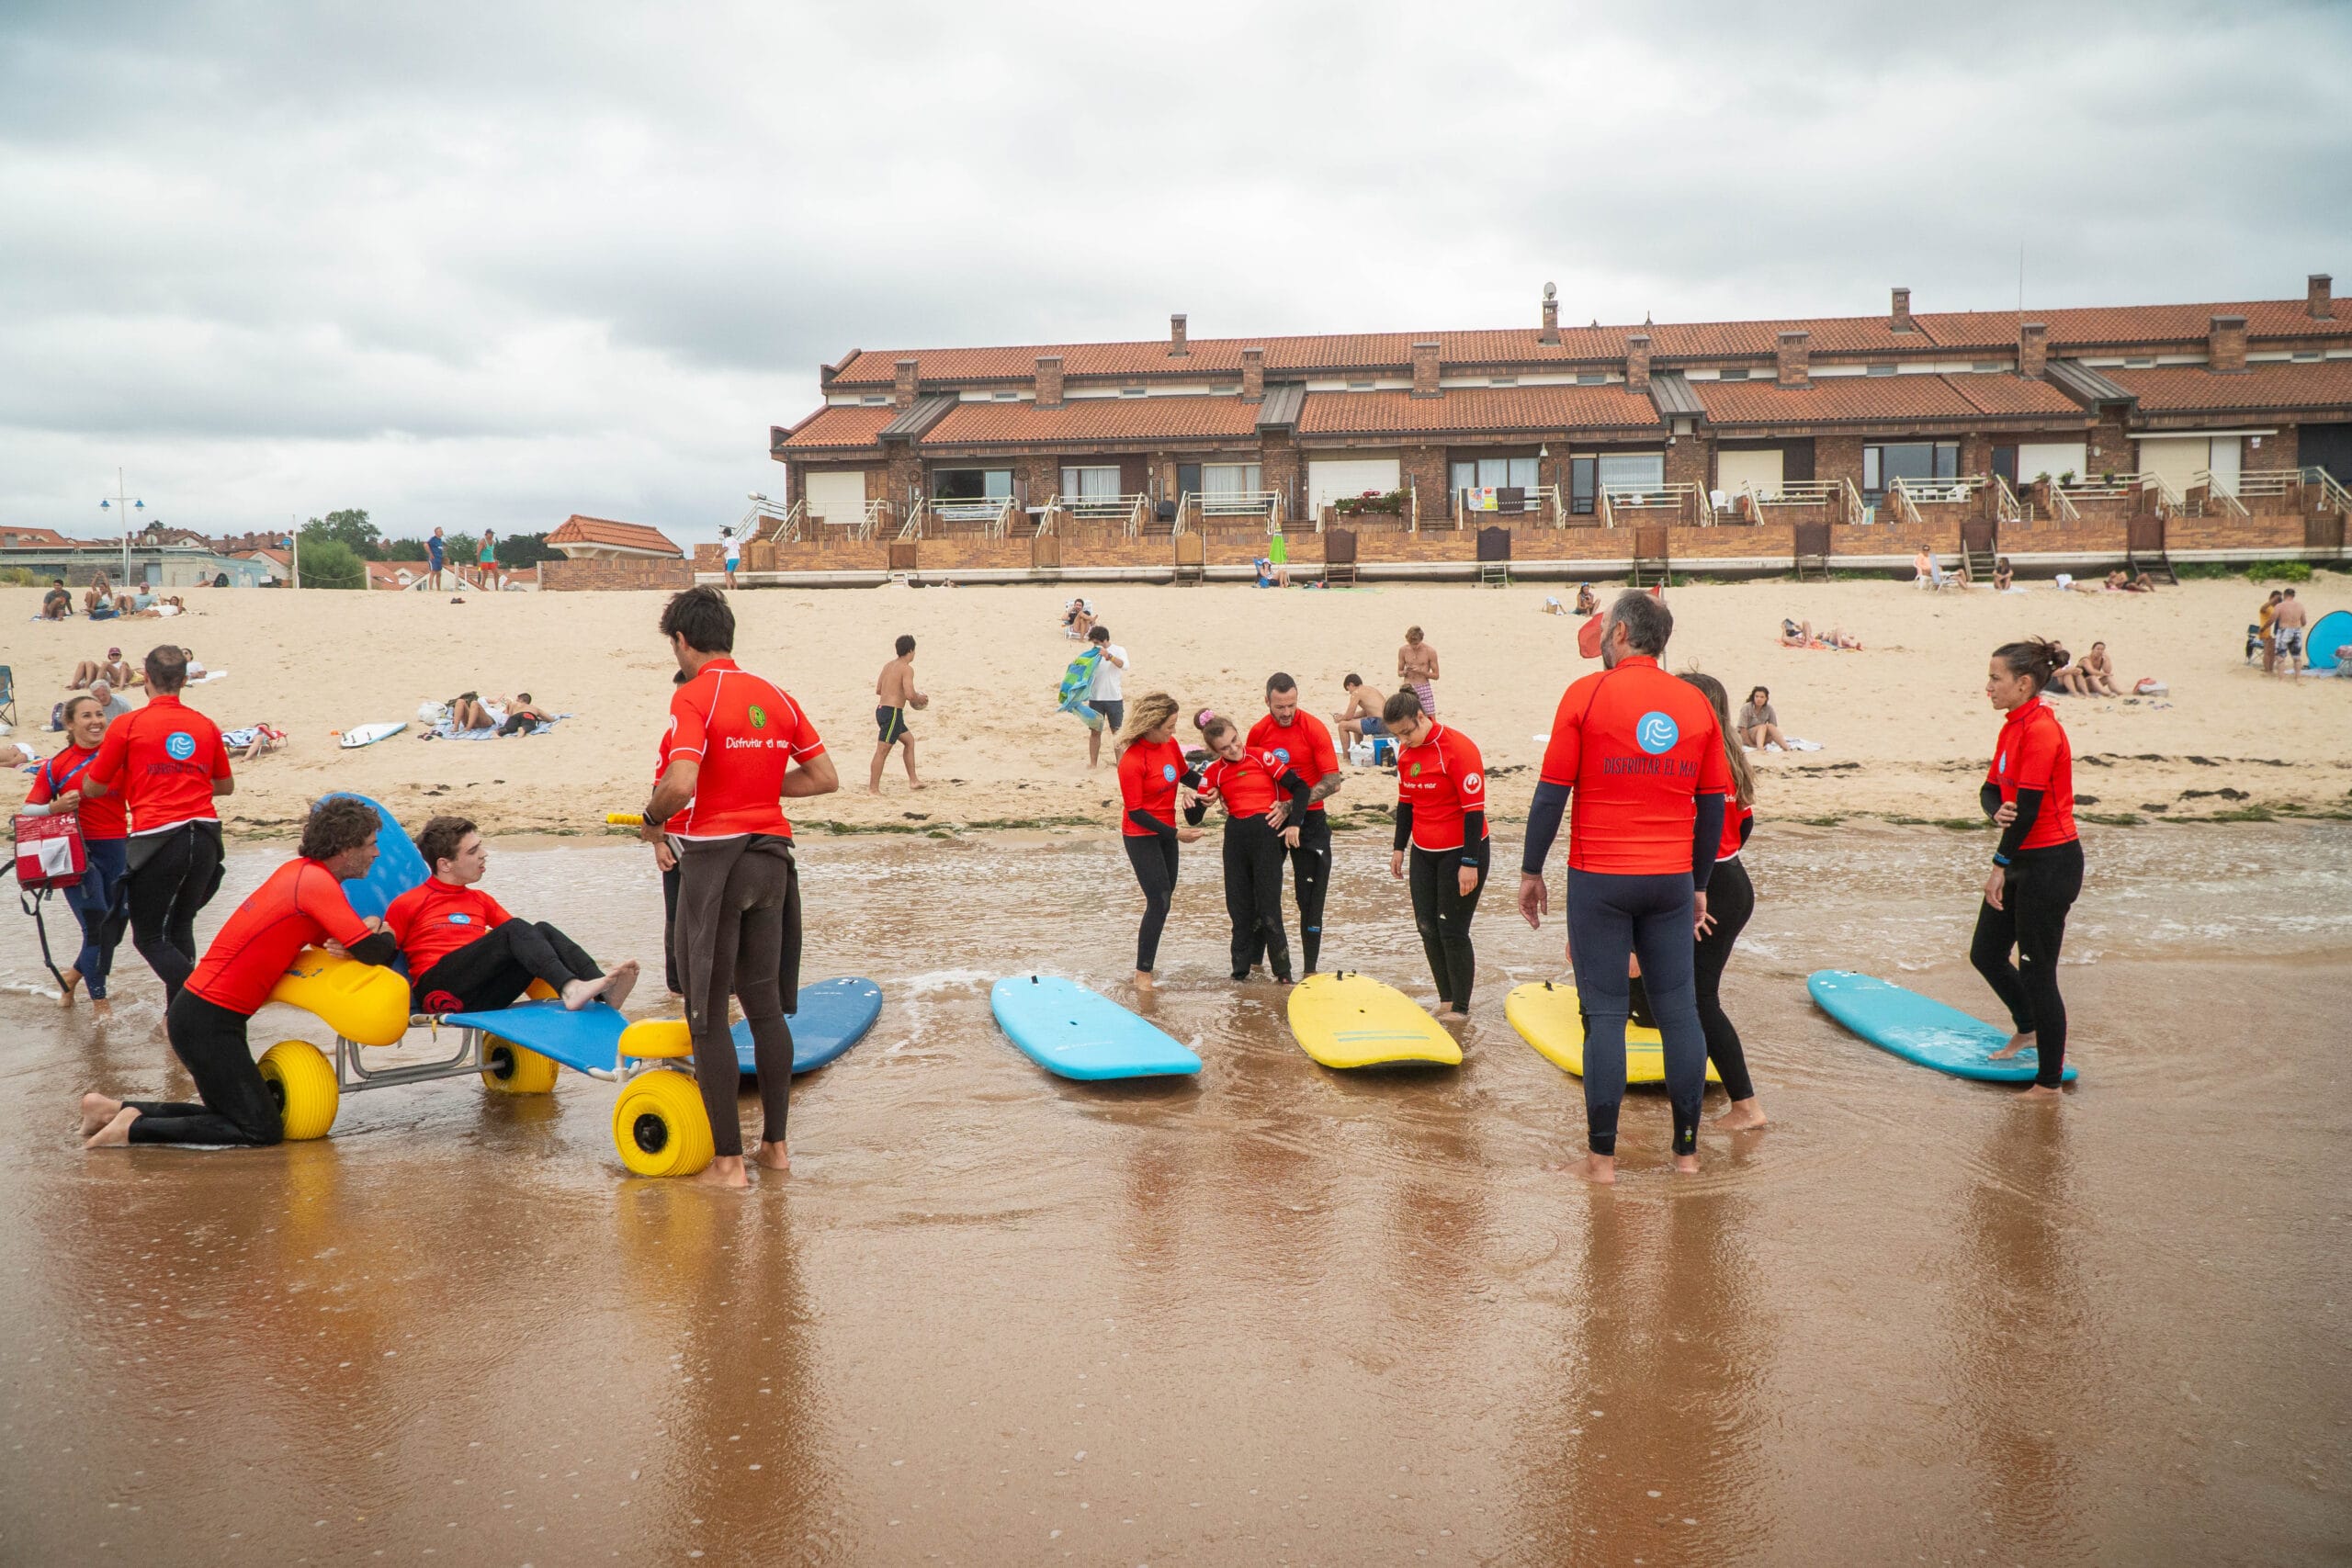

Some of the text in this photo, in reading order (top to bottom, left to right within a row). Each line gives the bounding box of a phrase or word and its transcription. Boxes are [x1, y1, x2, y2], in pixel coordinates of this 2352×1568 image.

[726, 737, 763, 749] Disfrutar
[776, 739, 789, 749] mar
[1603, 757, 1661, 774] DISFRUTAR
[1664, 758, 1675, 775] EL
